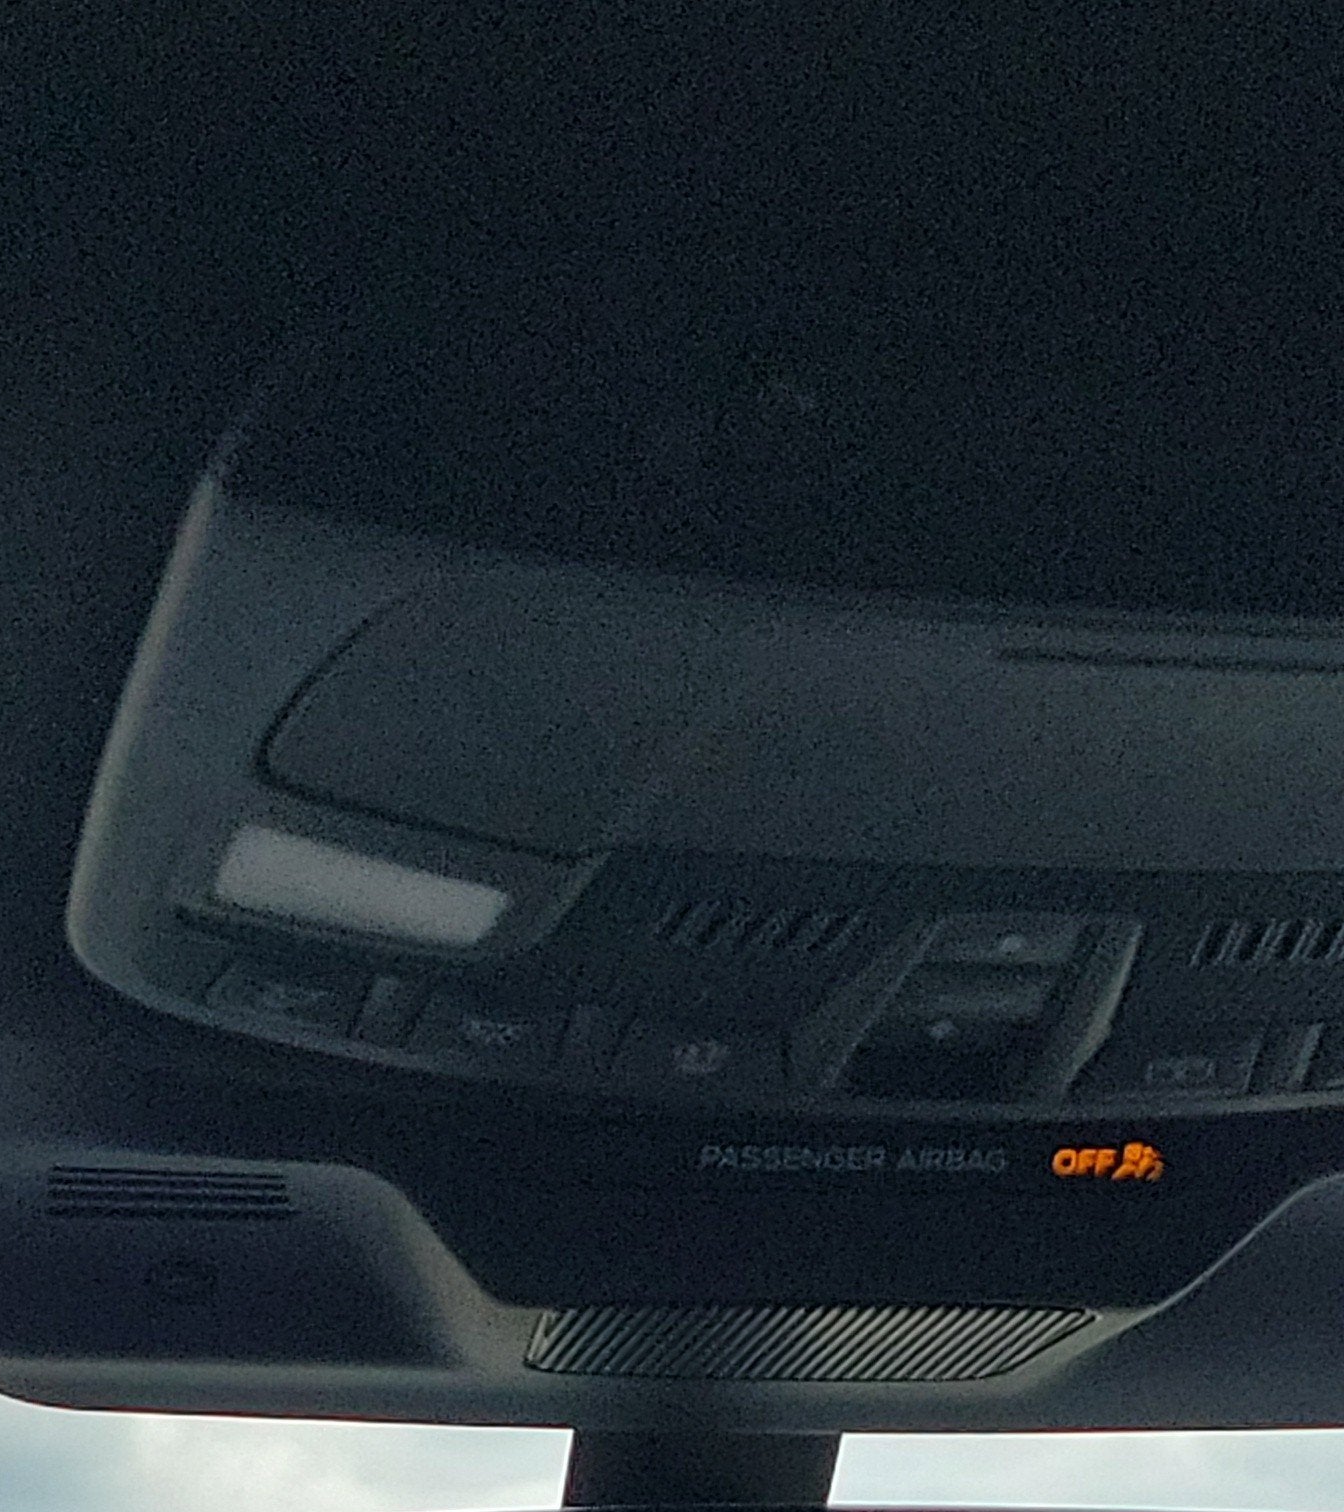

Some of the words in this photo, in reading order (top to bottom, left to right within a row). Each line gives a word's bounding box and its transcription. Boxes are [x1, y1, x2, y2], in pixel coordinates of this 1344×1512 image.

[698, 1145, 887, 1171] PASSENGER
[896, 1146, 1008, 1172] AIRBAG
[1053, 1148, 1117, 1176] OFF
